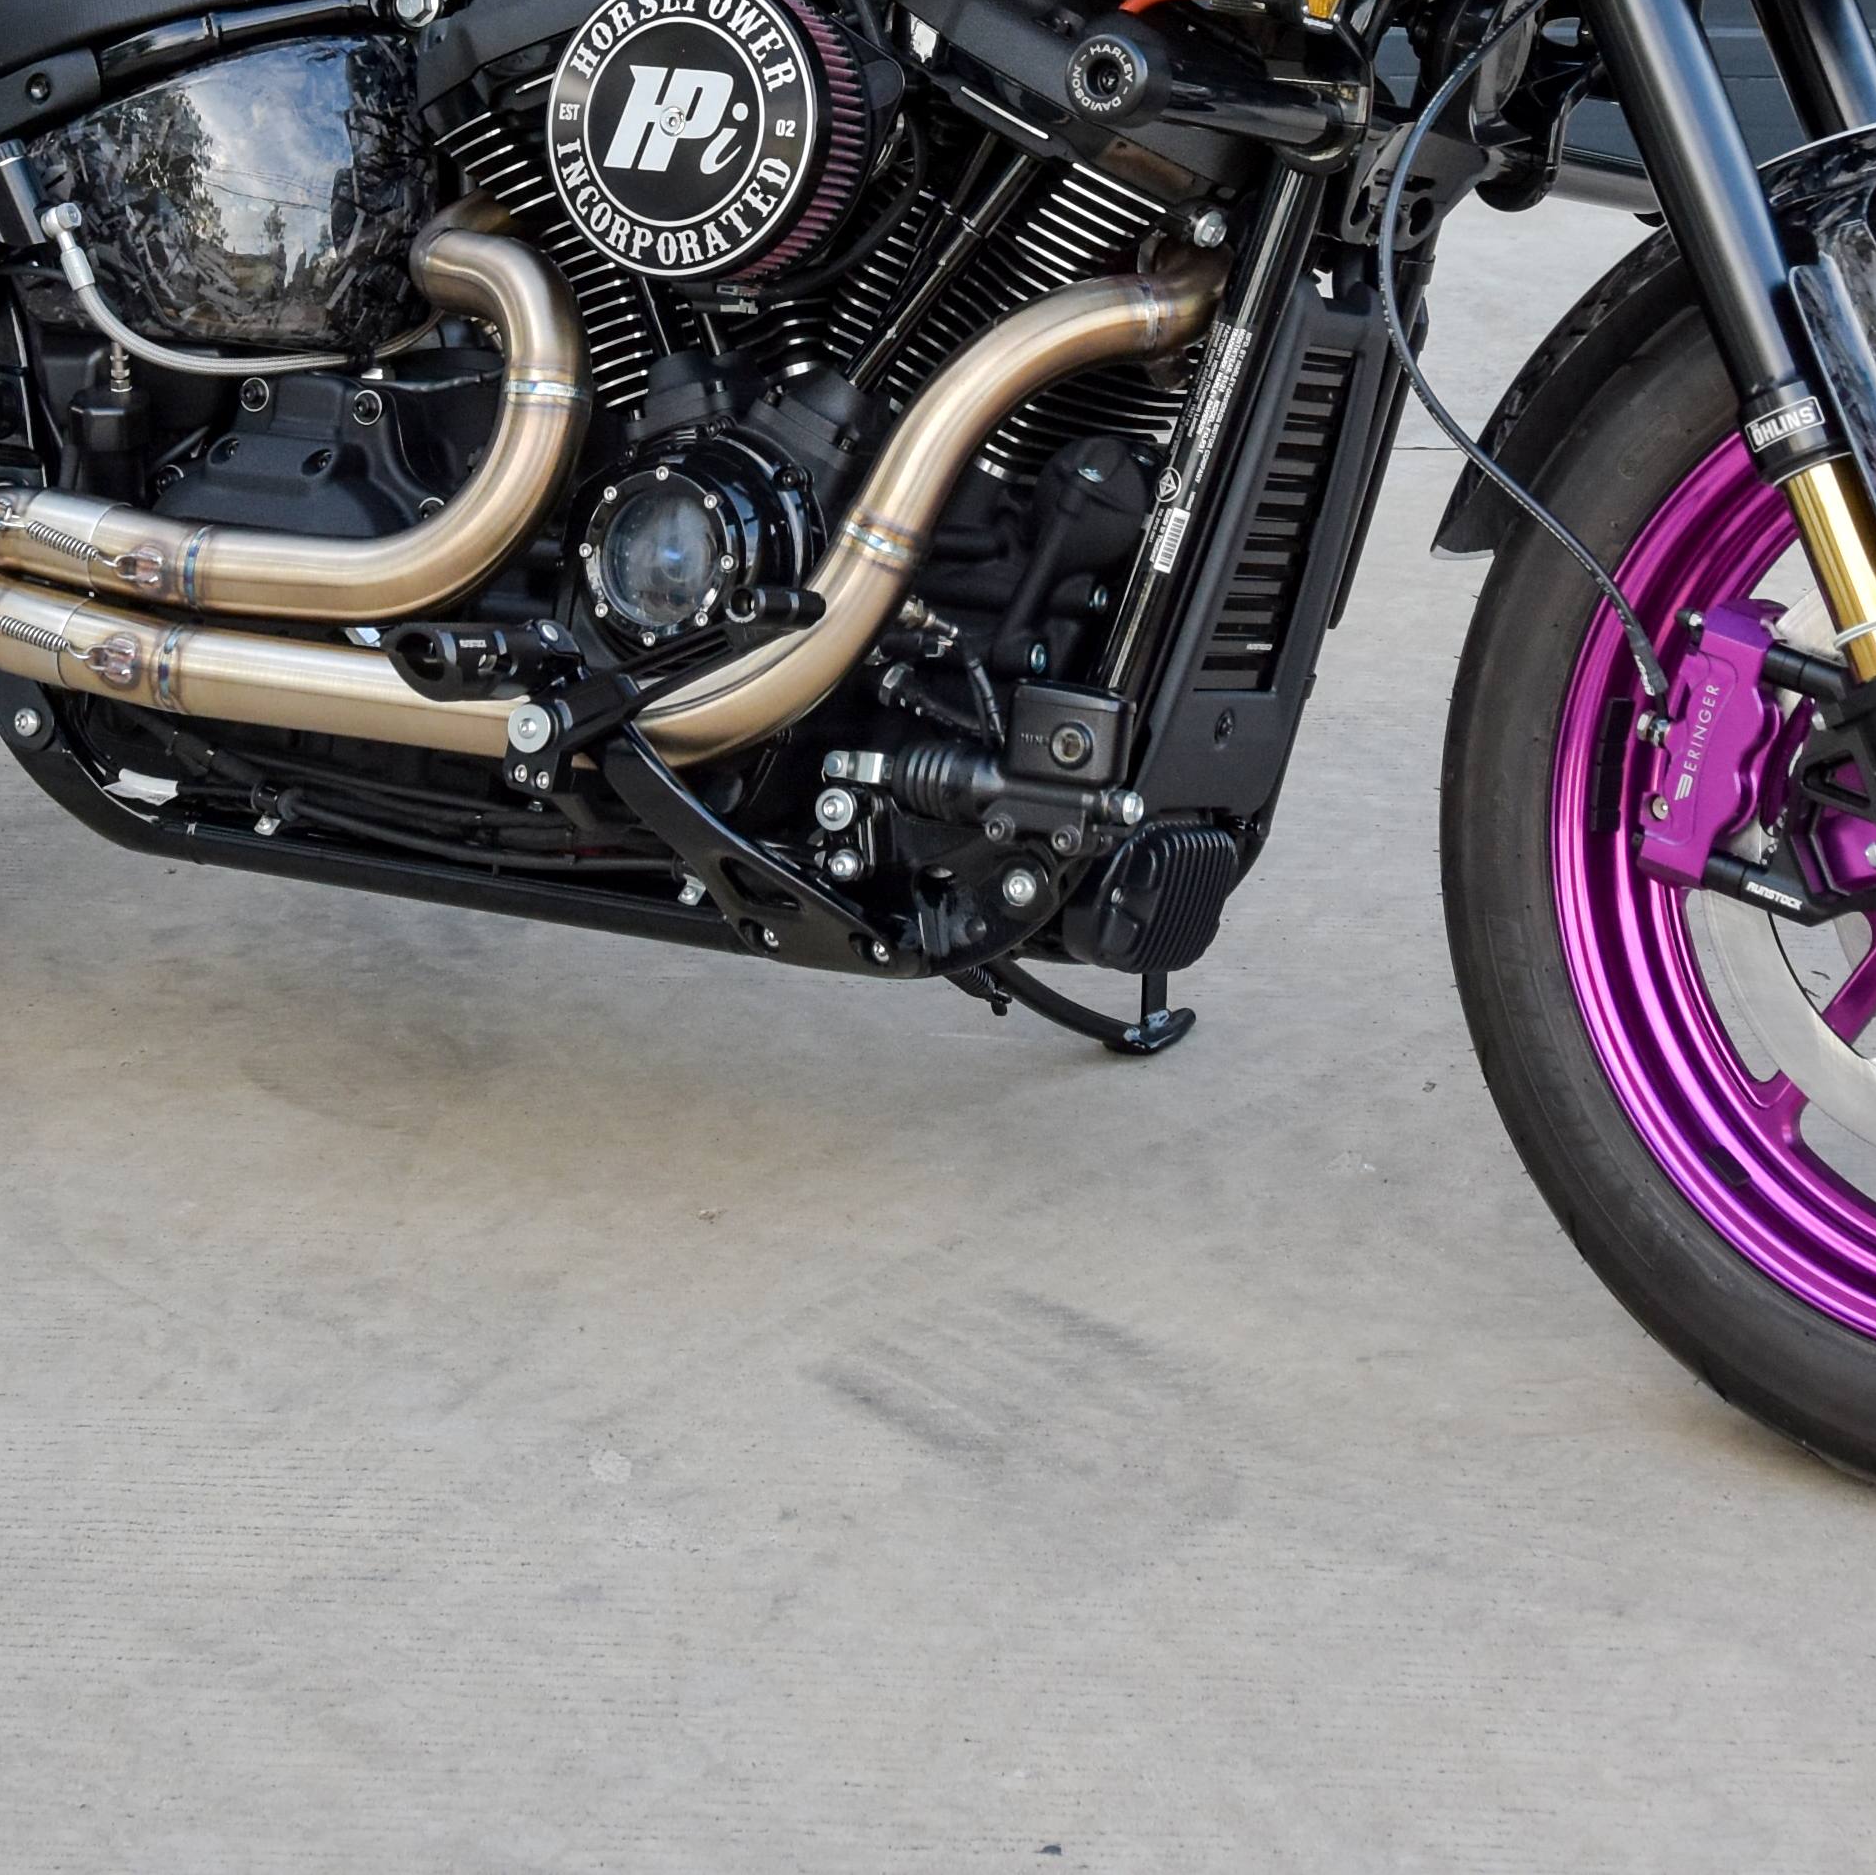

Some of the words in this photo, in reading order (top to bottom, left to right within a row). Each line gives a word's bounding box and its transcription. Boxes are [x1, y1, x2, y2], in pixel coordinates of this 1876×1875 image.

[1089, 43, 1134, 84] HARLEY
[1071, 63, 1123, 112] DAVIDSON
[559, 103, 580, 122] EST
[775, 119, 796, 138] 02
[557, 137, 792, 265] INCORPORATED
[1750, 405, 1816, 447] ÖHLINS
[1674, 683, 1721, 801] BERINGER
